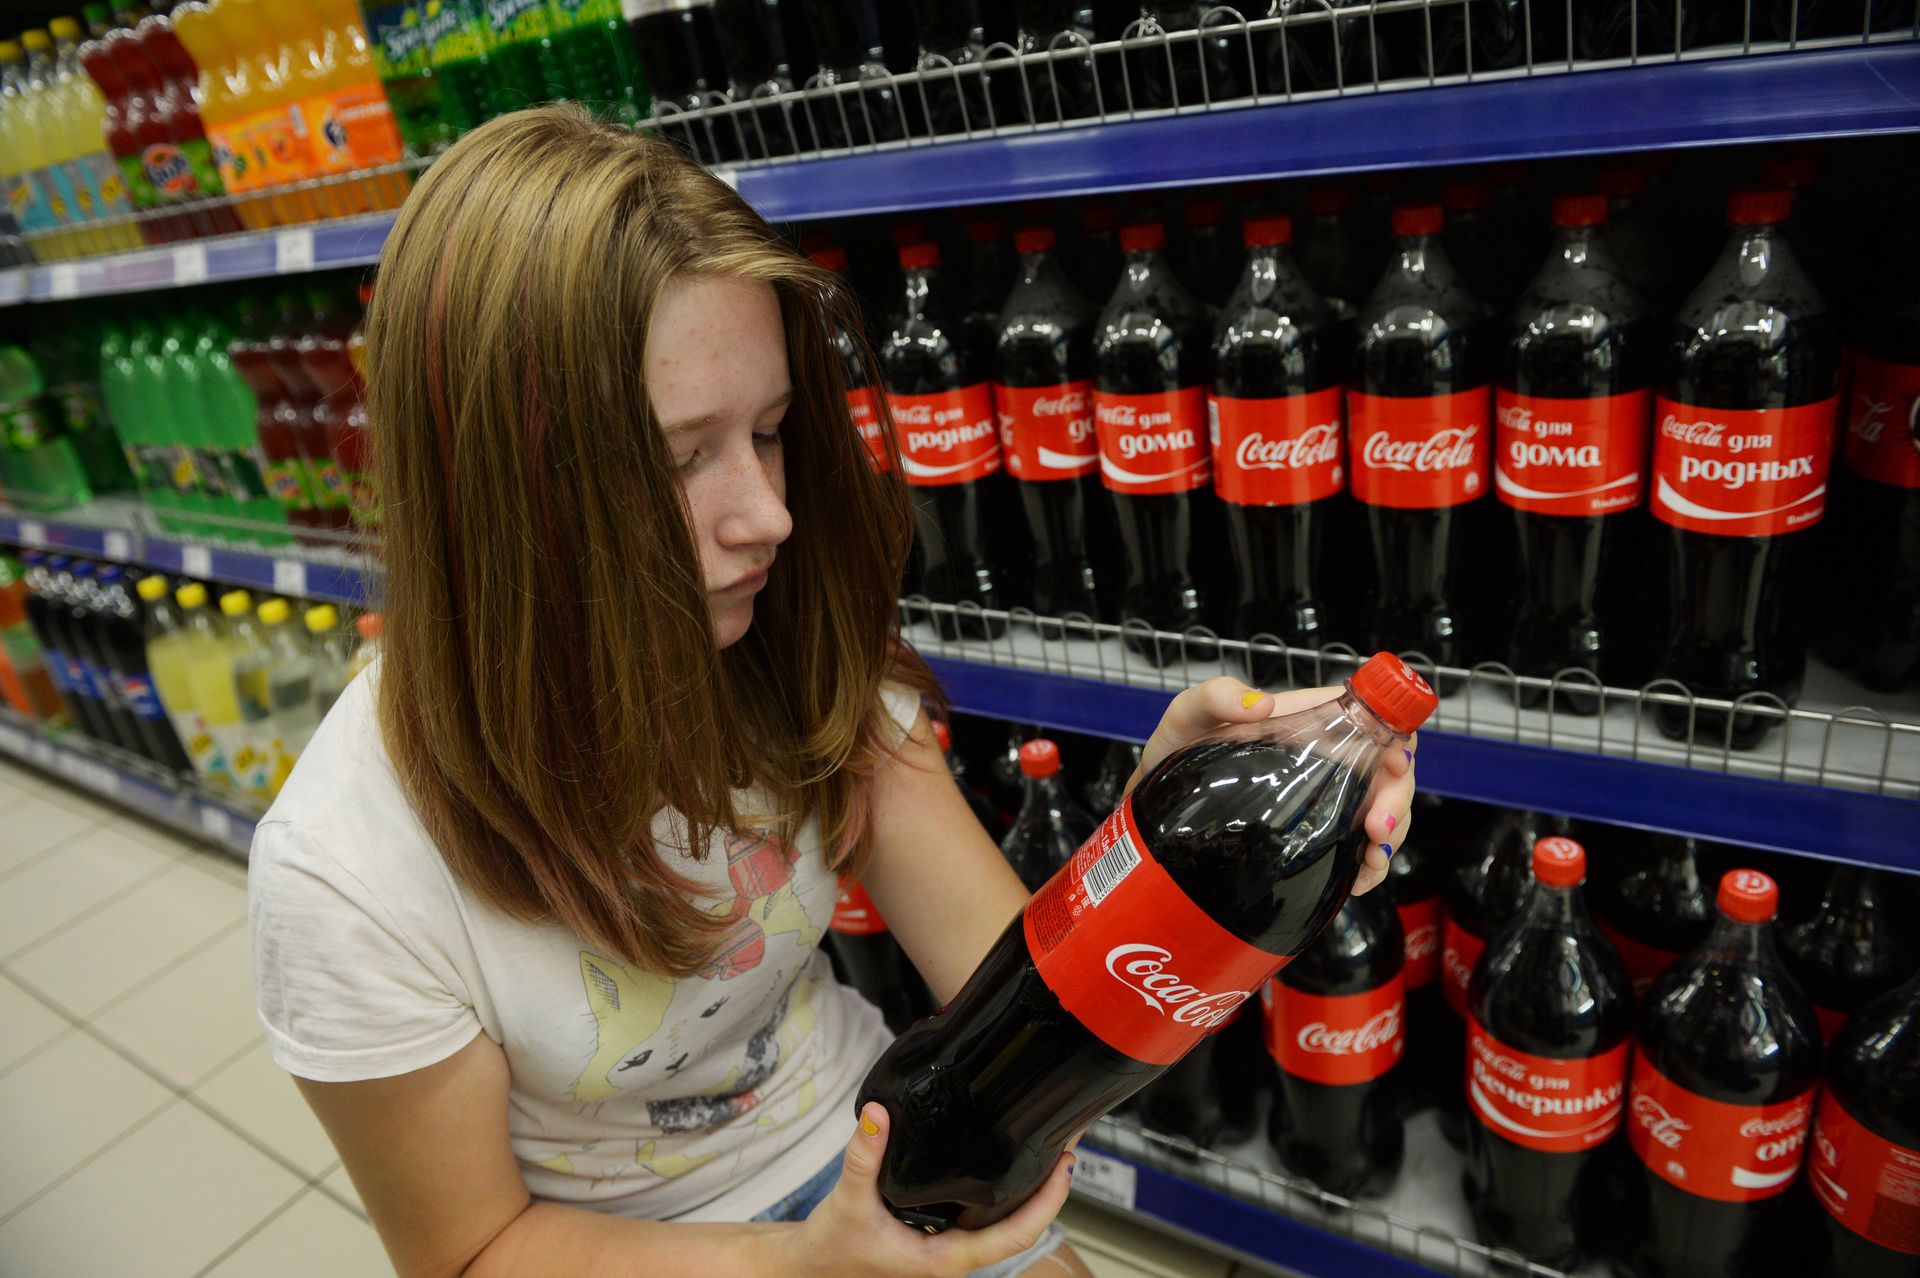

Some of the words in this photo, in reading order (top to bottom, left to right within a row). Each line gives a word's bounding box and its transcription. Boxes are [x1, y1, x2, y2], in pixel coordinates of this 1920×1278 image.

[1119, 429, 1196, 460] дома
[1236, 420, 1340, 470] Coca-Cola
[1363, 424, 1479, 471] Coca-Cola
[1534, 420, 1573, 439] для
[1662, 414, 1727, 447] Coca-Cola
[1728, 433, 1773, 453] для
[1510, 440, 1602, 469] дома
[1679, 454, 1814, 489] родных
[1298, 1003, 1401, 1055] Coca-Cola
